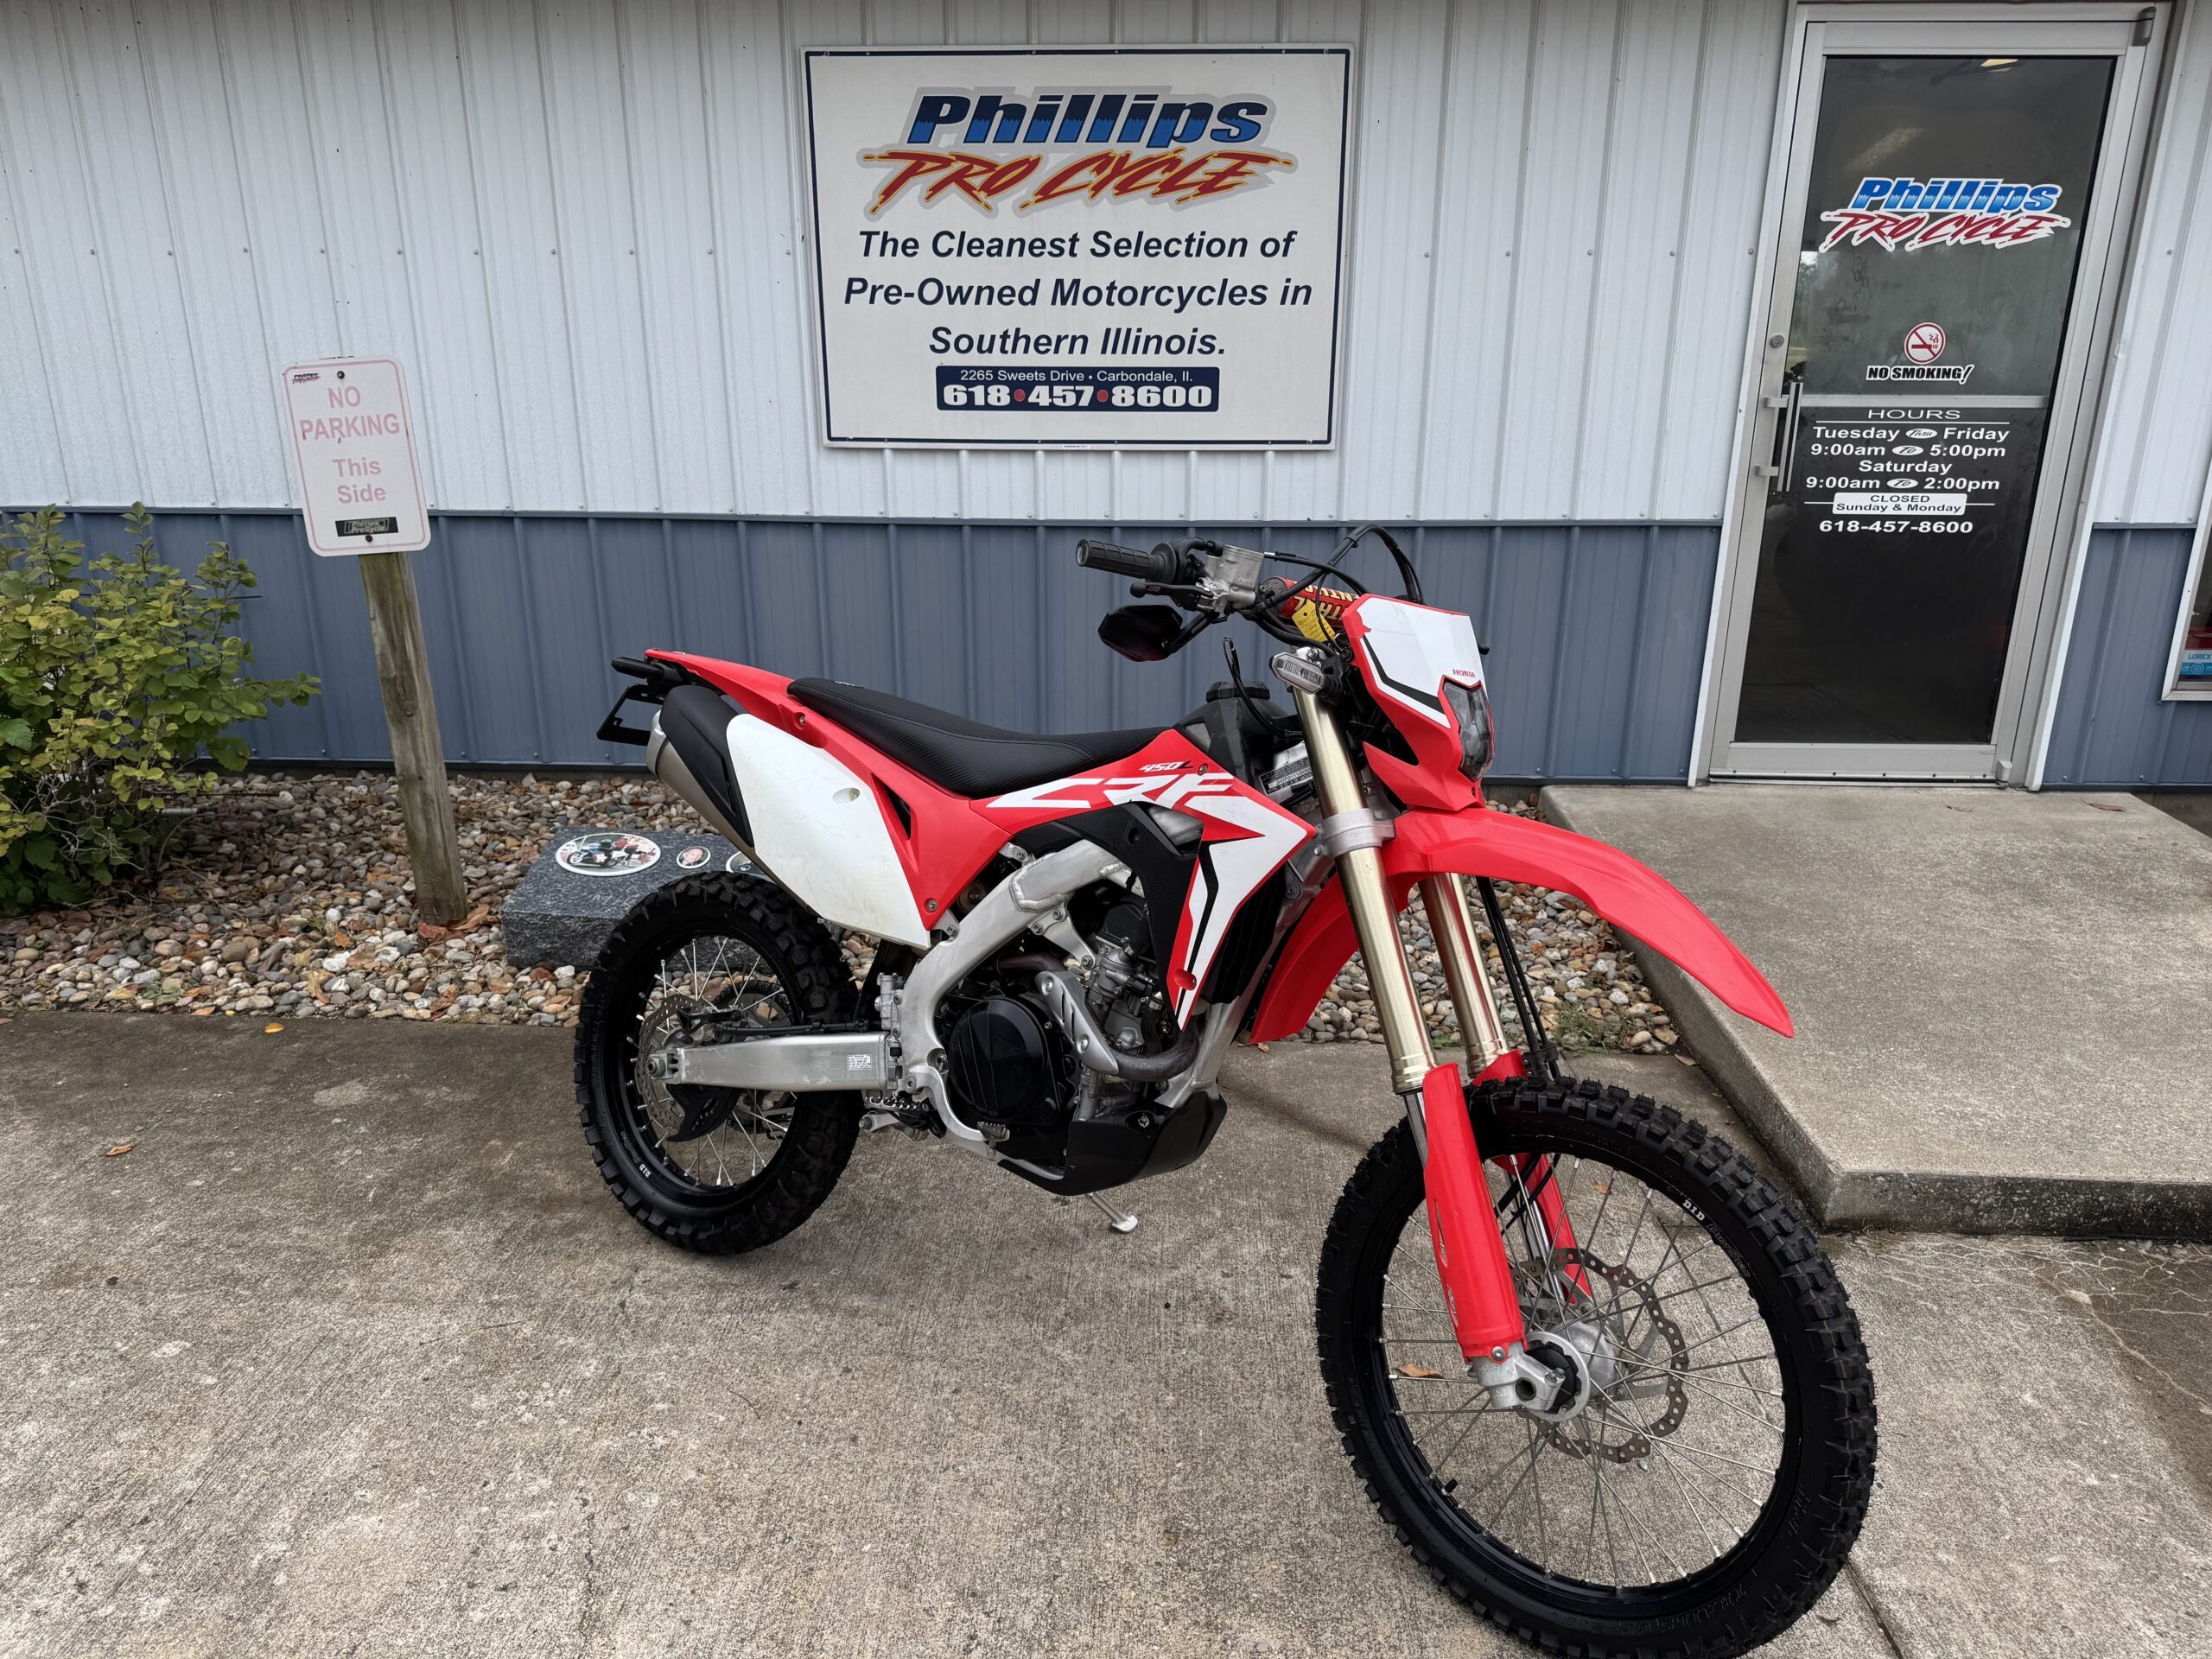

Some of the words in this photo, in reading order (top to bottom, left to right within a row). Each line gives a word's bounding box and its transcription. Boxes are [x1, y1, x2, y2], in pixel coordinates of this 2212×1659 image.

[906, 94, 1268, 149] Phillips
[863, 149, 1043, 214] PRO
[1020, 147, 1294, 211] CYCLE
[1849, 179, 2061, 213] Phillips
[1821, 212, 1929, 252] PRO
[1906, 213, 2070, 251] CYCLE
[858, 231, 919, 257] The
[931, 230, 1079, 257] Cleanest
[1090, 231, 1248, 257] Selection
[1260, 231, 1298, 257] of
[844, 277, 1040, 306] Pre-Owned
[1051, 277, 1268, 313] Motorcycles
[1280, 277, 1313, 306] in
[929, 326, 1088, 354] Southern
[1100, 327, 1225, 354] Illinois.
[960, 370, 993, 381] 2265
[998, 370, 1046, 381] Sweets
[1050, 370, 1084, 381] Drive
[1096, 371, 1177, 383] Carbondale,
[1867, 366, 1890, 380] NO
[1892, 365, 1974, 383] SMOKING!
[327, 385, 361, 409] NO
[1867, 410, 1961, 420] HOURS
[299, 413, 400, 441] PARKING
[1813, 427, 1900, 442] Tuesday
[1943, 428, 2010, 442] Friday
[1810, 443, 1885, 455] 9:00am
[1929, 444, 2006, 459] 5:00pm
[332, 457, 381, 477] This
[1859, 460, 1953, 475] Saturday
[337, 484, 386, 504] Side
[1805, 477, 1880, 489] 9:00am
[1923, 478, 1999, 492] 2:00pm
[1836, 504, 1888, 512] Sunday
[1906, 505, 1961, 513] Monday
[1819, 520, 1974, 534] 618-457-8600
[1452, 669, 1477, 678] HONDA
[986, 772, 1235, 809] CRF
